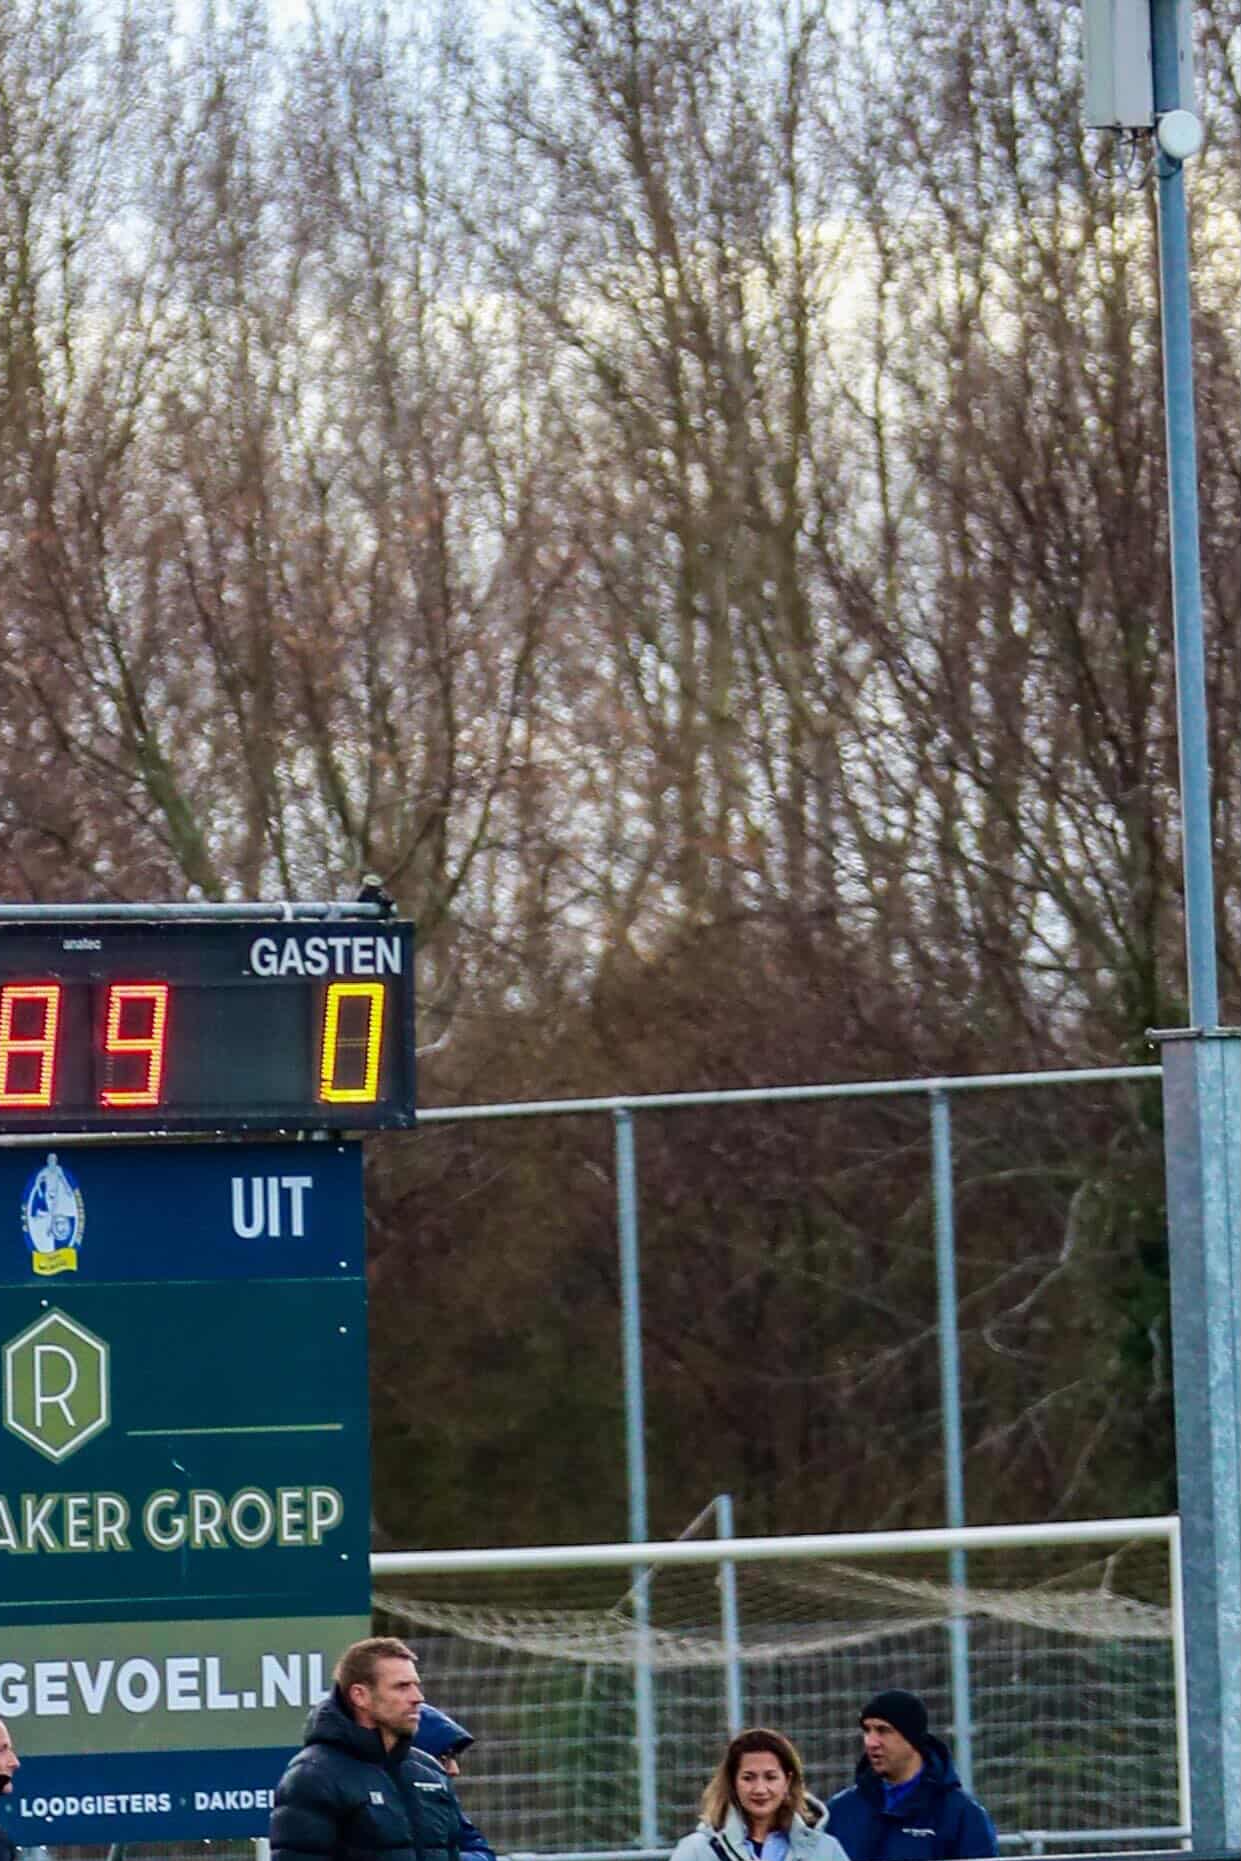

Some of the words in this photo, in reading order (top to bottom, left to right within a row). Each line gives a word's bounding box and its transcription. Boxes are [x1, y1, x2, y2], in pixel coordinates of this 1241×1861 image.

[250, 936, 401, 976] GASTEN
[318, 982, 385, 1103] 0
[232, 1176, 312, 1239] UIT
[34, 1344, 78, 1427] R
[144, 1489, 341, 1547] GROEP
[20, 1793, 171, 1818] LOODGIETERS
[195, 1789, 275, 1810] DAKDE
